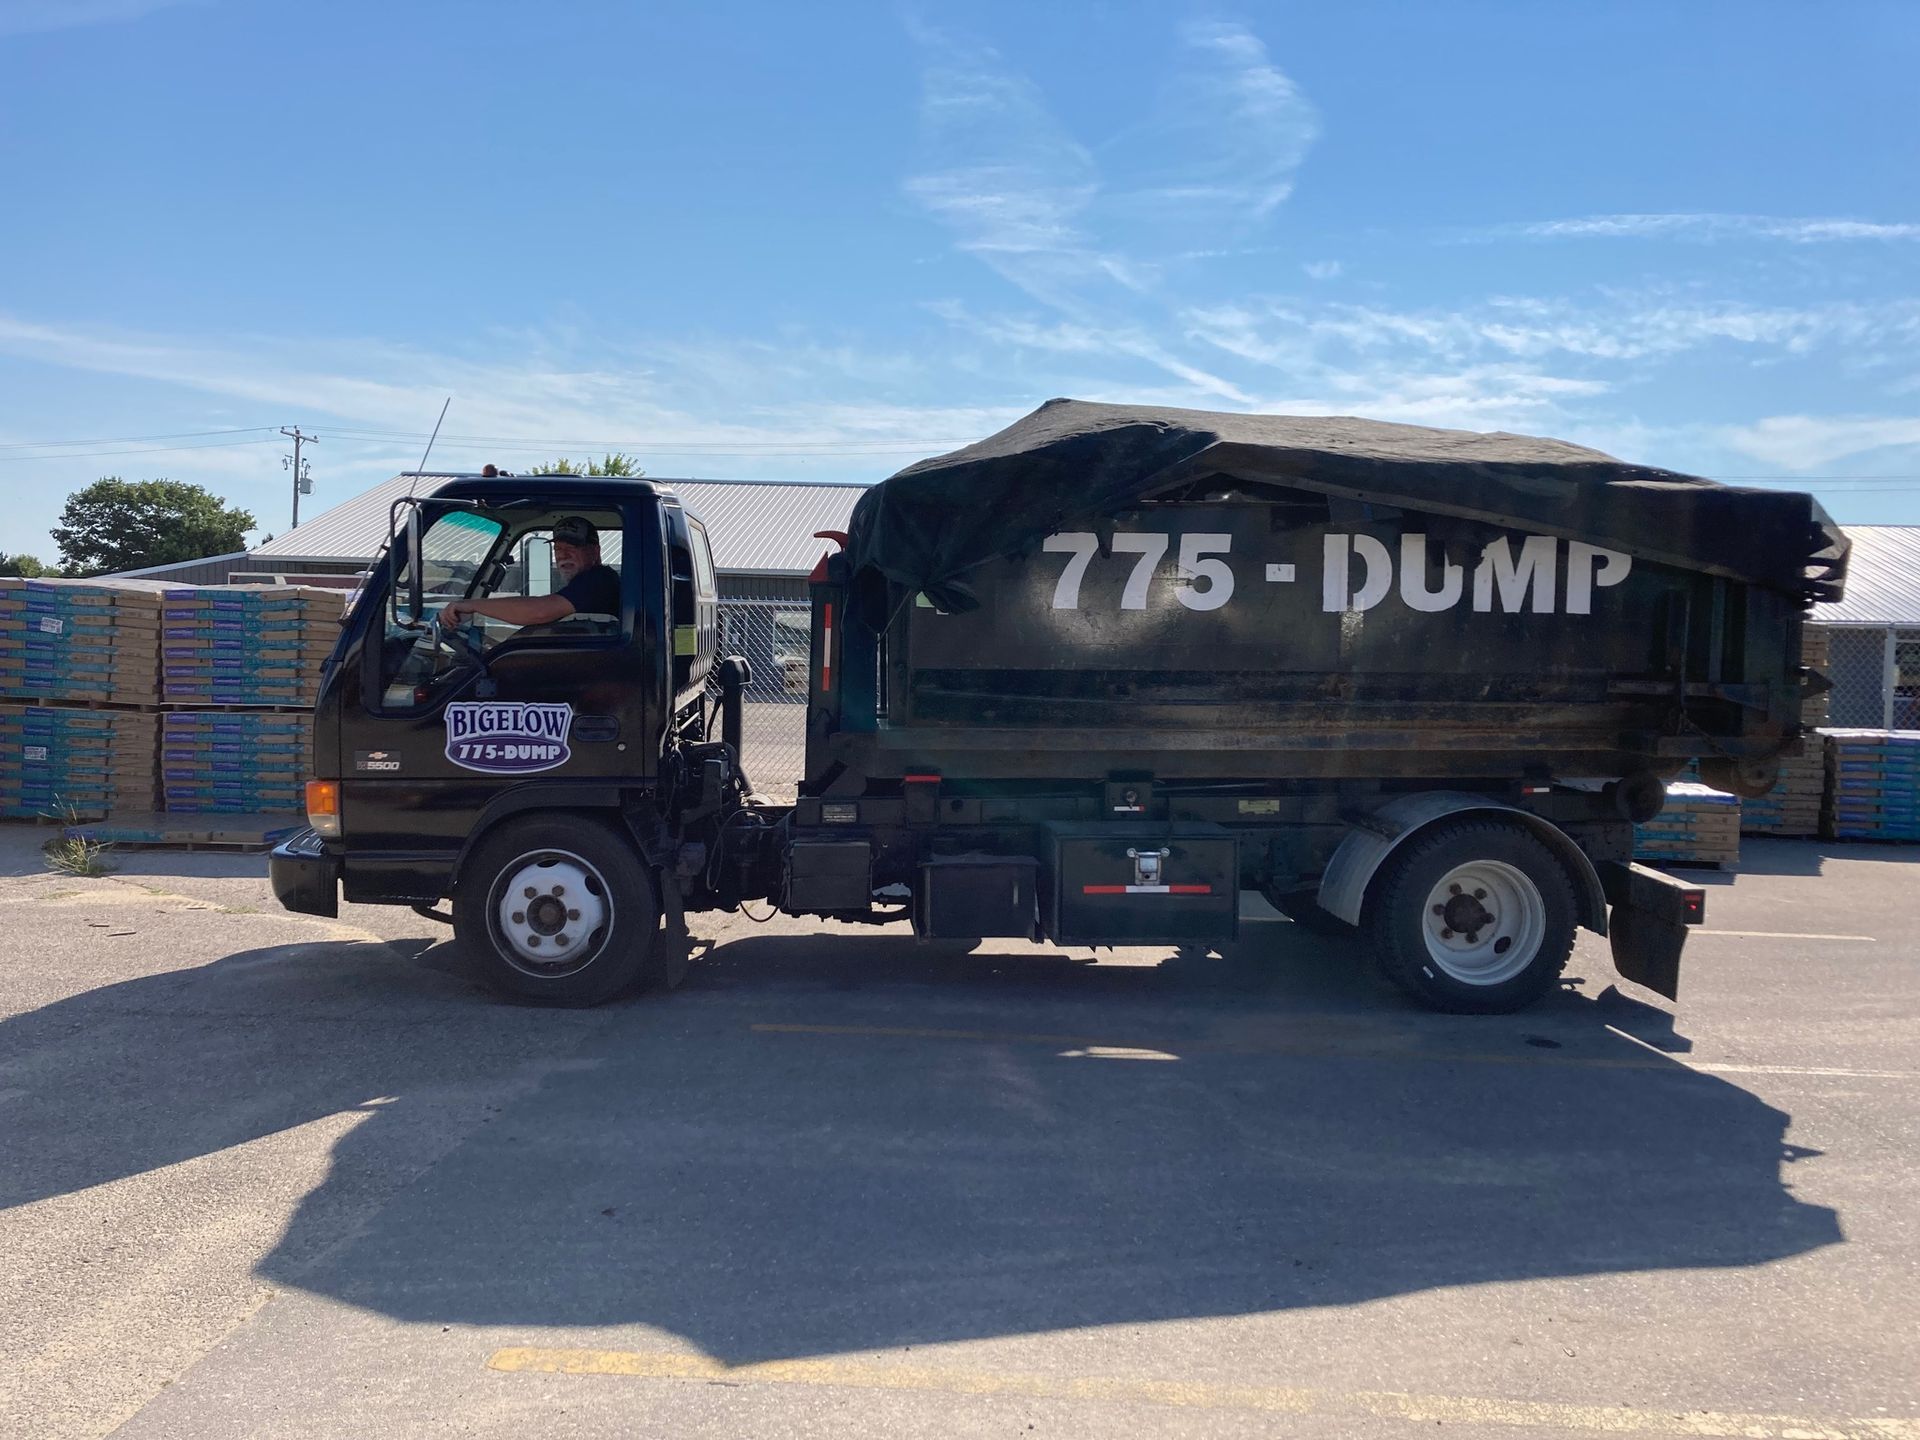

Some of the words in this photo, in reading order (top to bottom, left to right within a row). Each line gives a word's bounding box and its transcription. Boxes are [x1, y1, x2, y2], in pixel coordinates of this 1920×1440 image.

[1042, 532, 1235, 611] 775
[1322, 533, 1633, 615] DUMP
[452, 709, 567, 738] BIGELOW
[458, 744, 562, 760] 775-DUMP
